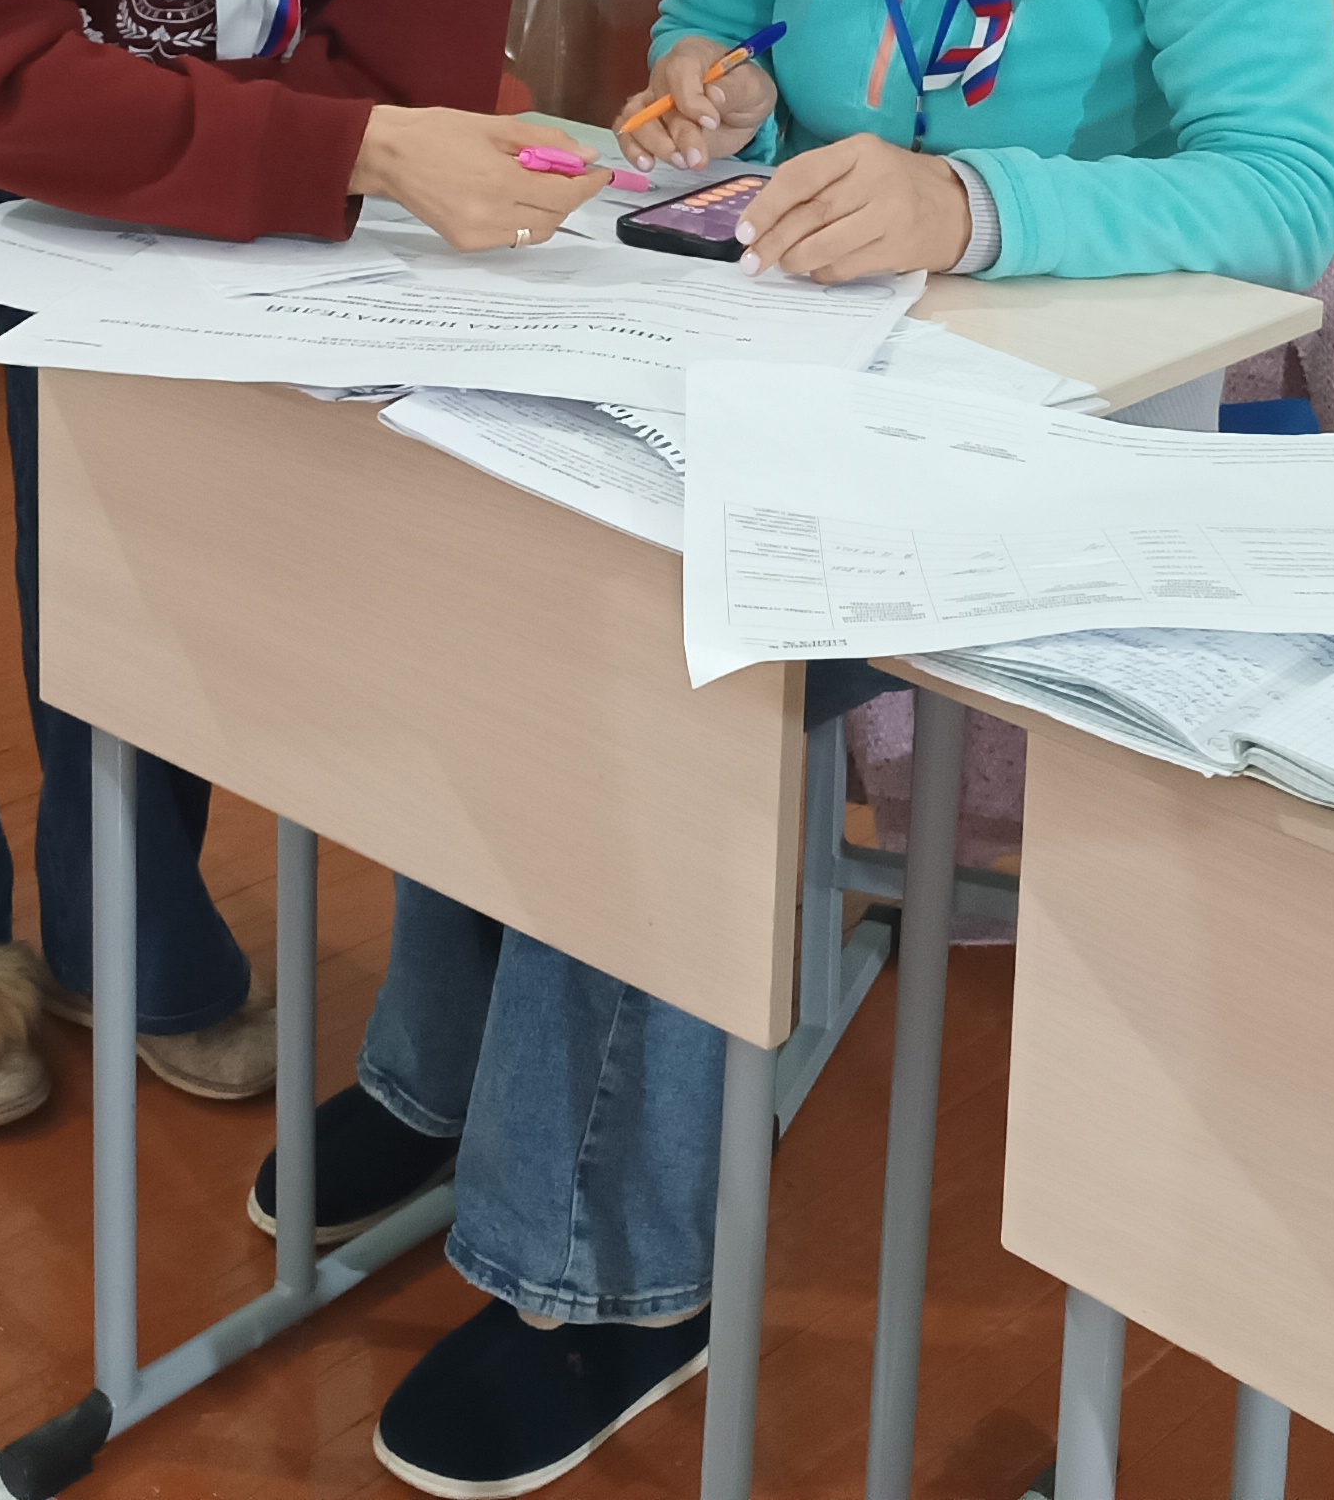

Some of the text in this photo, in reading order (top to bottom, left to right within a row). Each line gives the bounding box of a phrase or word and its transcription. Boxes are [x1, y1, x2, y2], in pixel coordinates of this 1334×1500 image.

[265, 304, 458, 329] ИЗБИРАТЕЛЕЙ
[467, 322, 579, 333] СПИСКА
[586, 324, 673, 343] КНИГА
